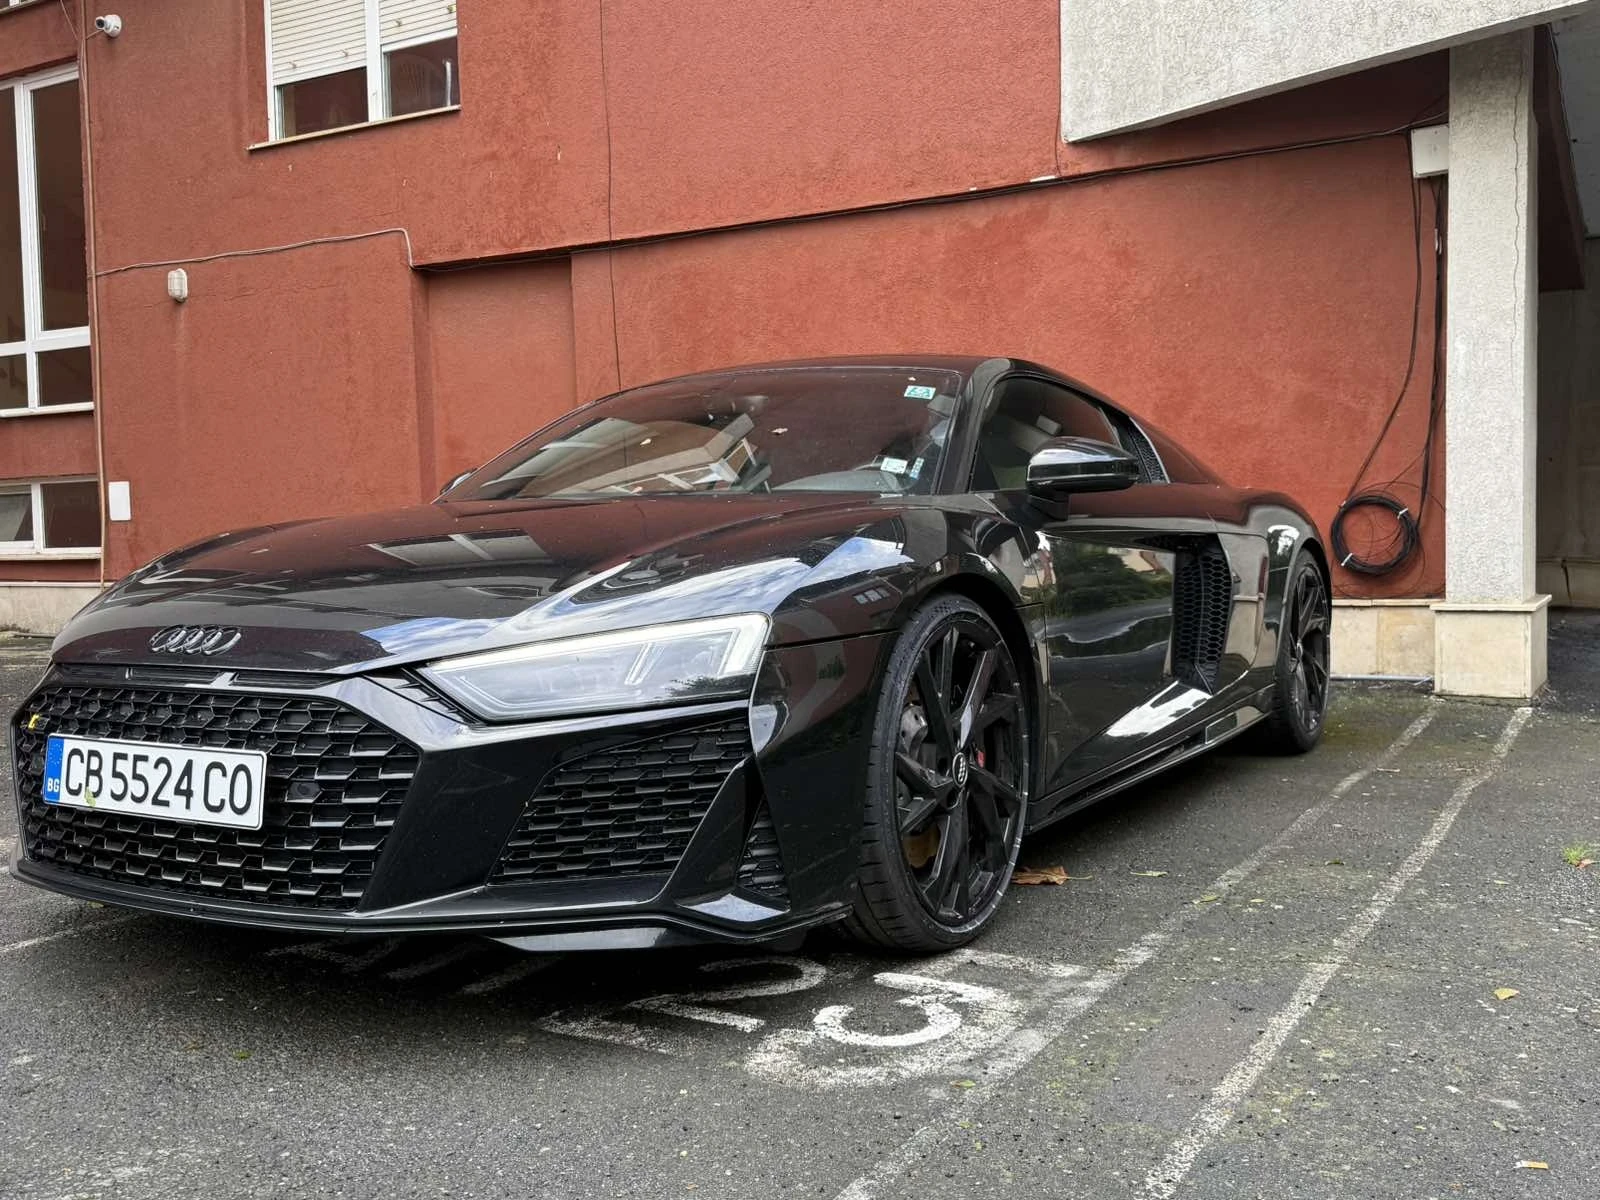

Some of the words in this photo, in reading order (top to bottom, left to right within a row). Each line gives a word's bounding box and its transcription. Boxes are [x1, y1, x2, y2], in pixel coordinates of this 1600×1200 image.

[47, 778, 60, 792] BG
[65, 747, 104, 799] CB
[110, 752, 194, 810] 5524
[203, 761, 252, 816] CO
